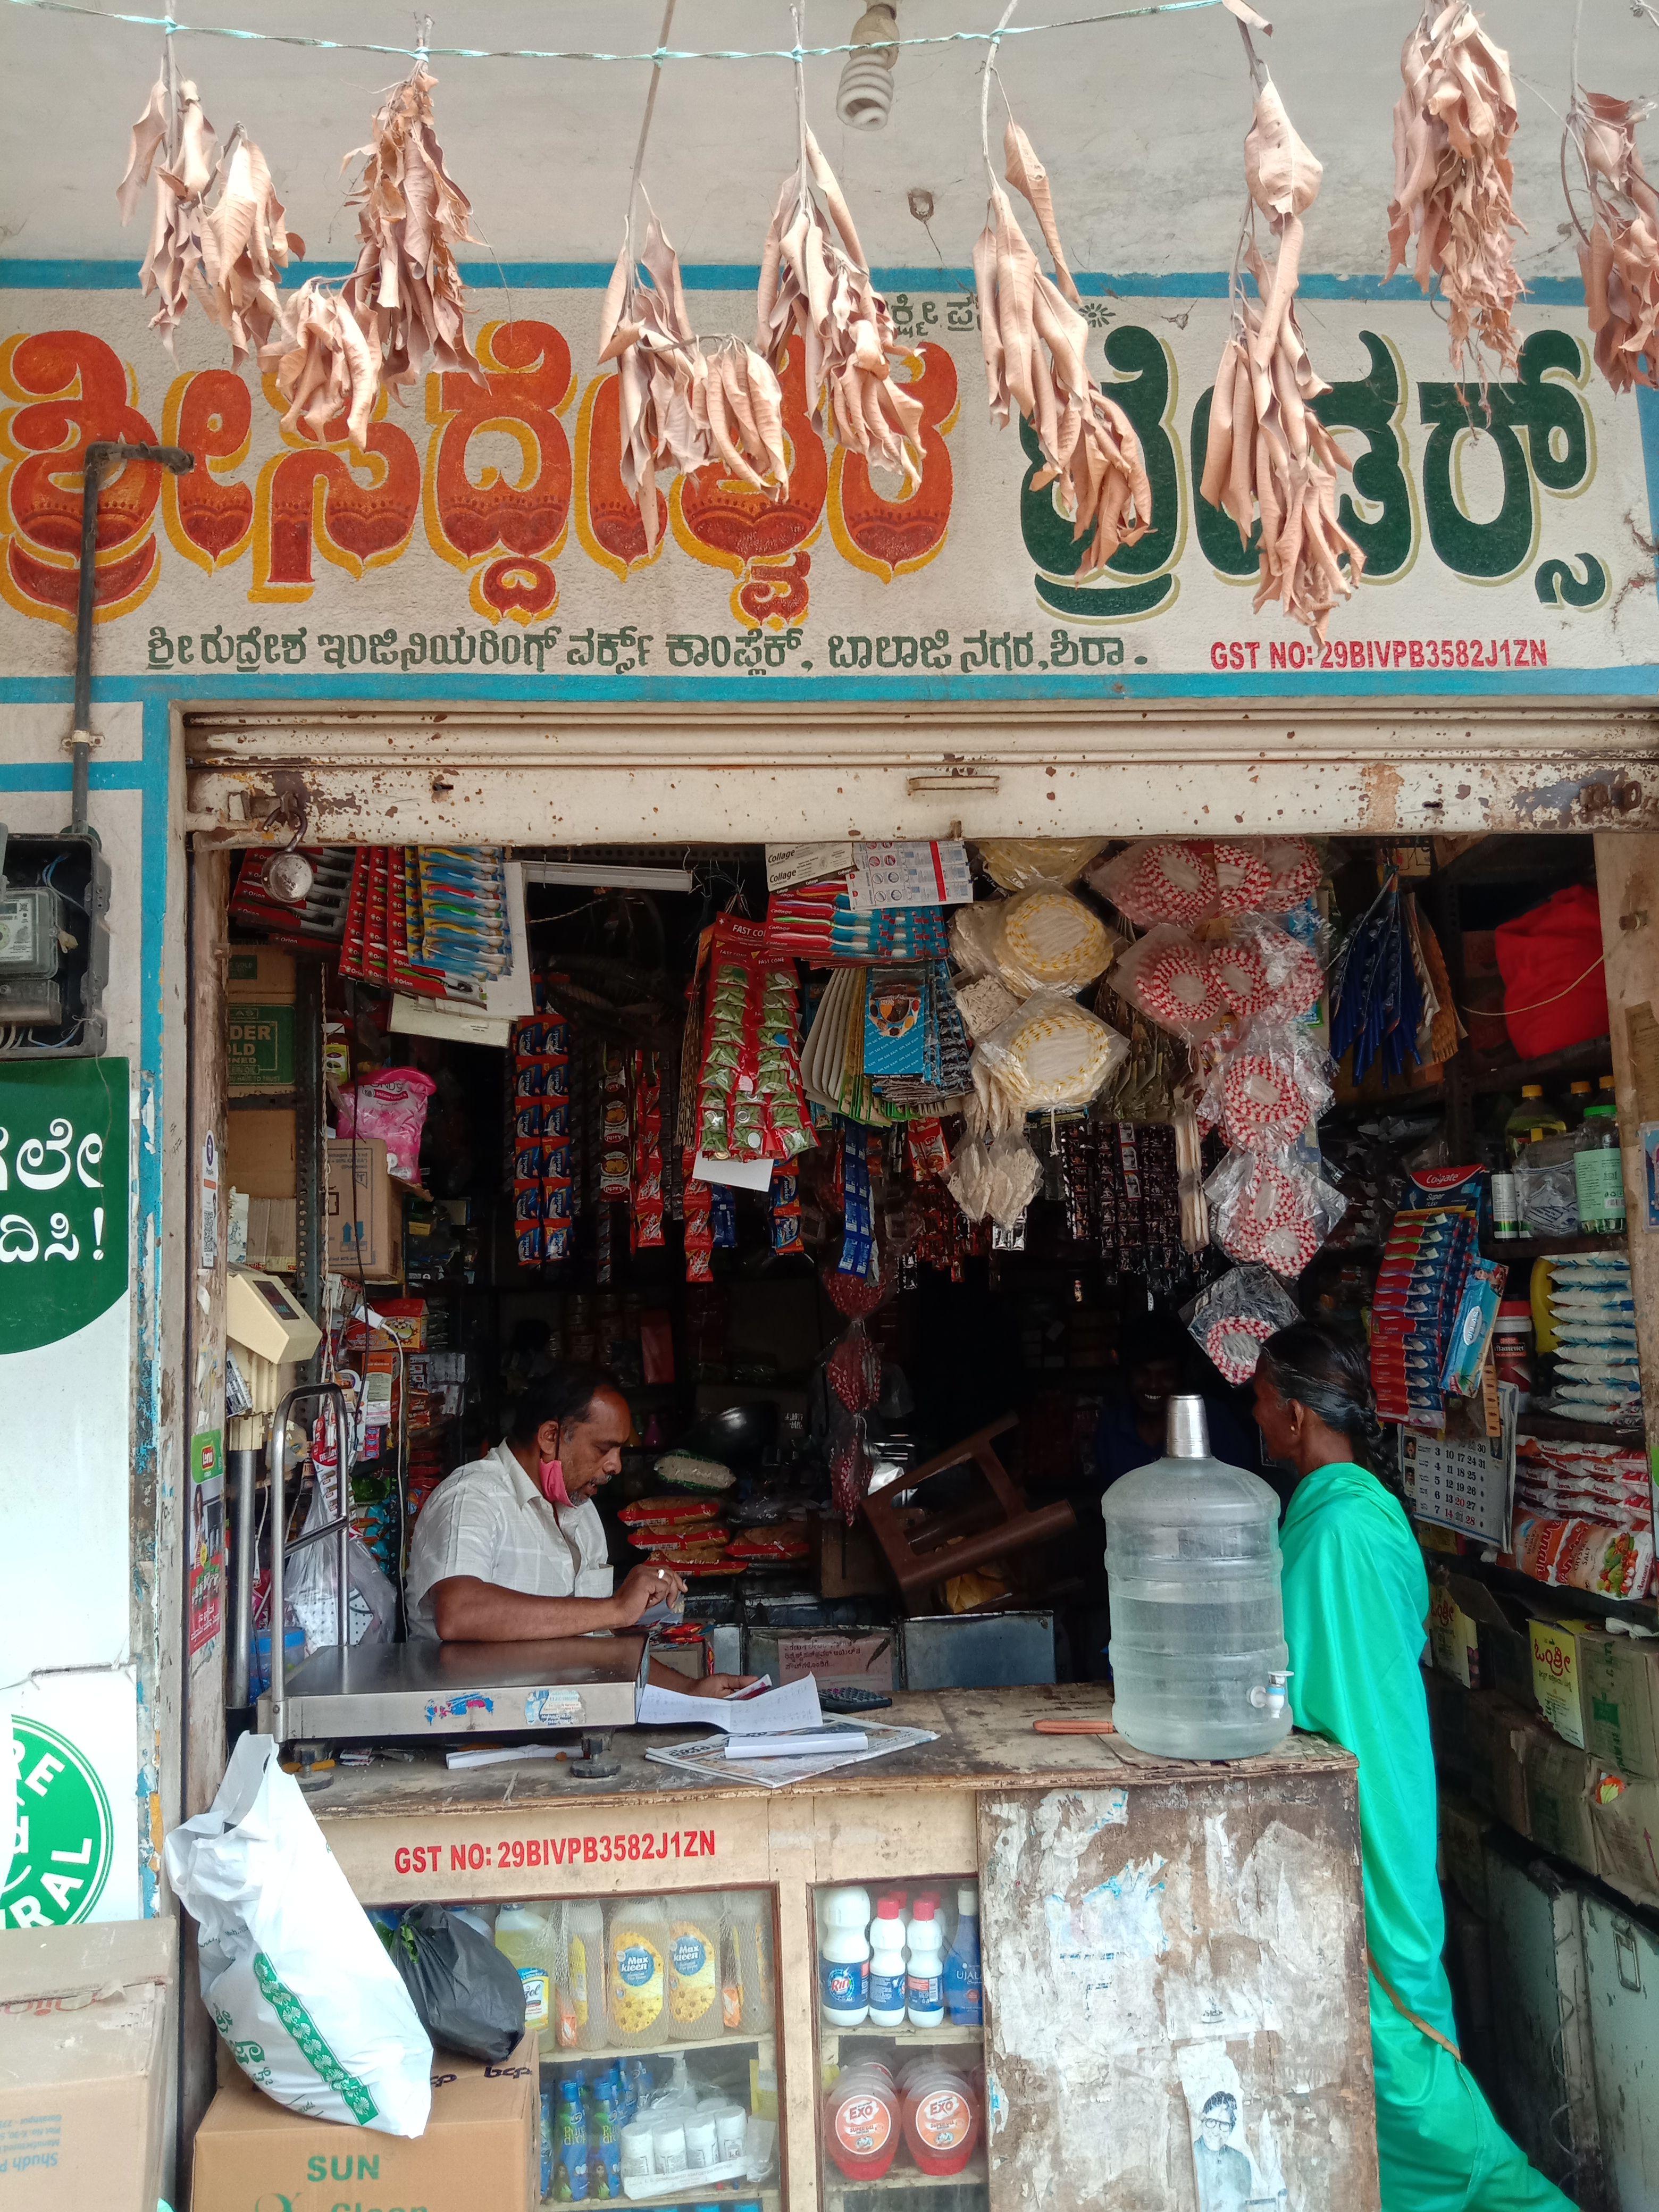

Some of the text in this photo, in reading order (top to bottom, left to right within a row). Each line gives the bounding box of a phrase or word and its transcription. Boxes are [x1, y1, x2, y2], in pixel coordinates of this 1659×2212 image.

[828, 629, 952, 669] ಬಾಲಾಜಿ
[1210, 639, 1548, 669] GST NO: 29BIVPB3582J1ZN
[768, 849, 795, 864] Collage
[770, 869, 797, 883] Collage
[248, 891, 266, 900] Orion
[732, 924, 752, 936] FAST
[398, 959, 413, 968] Orion
[398, 978, 414, 987] Orion
[230, 1025, 272, 1041] DER
[0, 1118, 104, 1191] ಲೇ
[1426, 1172, 1460, 1185] Colgate
[1477, 1443, 1486, 1454] 30
[1435, 1447, 1486, 1469] 3 10 17 24 31
[1434, 1462, 1476, 1481] 4 11 18 25
[1435, 1476, 1476, 1496] 5 12 19 26
[1435, 1490, 1476, 1511] 6 13 20 27
[1435, 1505, 1440, 1514] 7
[1445, 1508, 1453, 1518] 14
[1465, 1515, 1476, 1526] 28
[1582, 1546, 1591, 1566] SALT
[394, 1829, 716, 1874] GST NO: 29BIVPB3582J1ZN
[0, 1838, 92, 1929] RAL
[673, 1952, 699, 1962] kleen
[678, 1945, 700, 1954] Max
[621, 1963, 648, 1972] kleen
[627, 1956, 649, 1965] Max
[831, 1978, 850, 1992] Rin
[430, 2074, 458, 2088] cp
[849, 2105, 874, 2121] EXO
[929, 2100, 954, 2116] EXO
[12, 2152, 58, 2172] Shudh
[306, 2154, 381, 2182] SUN
